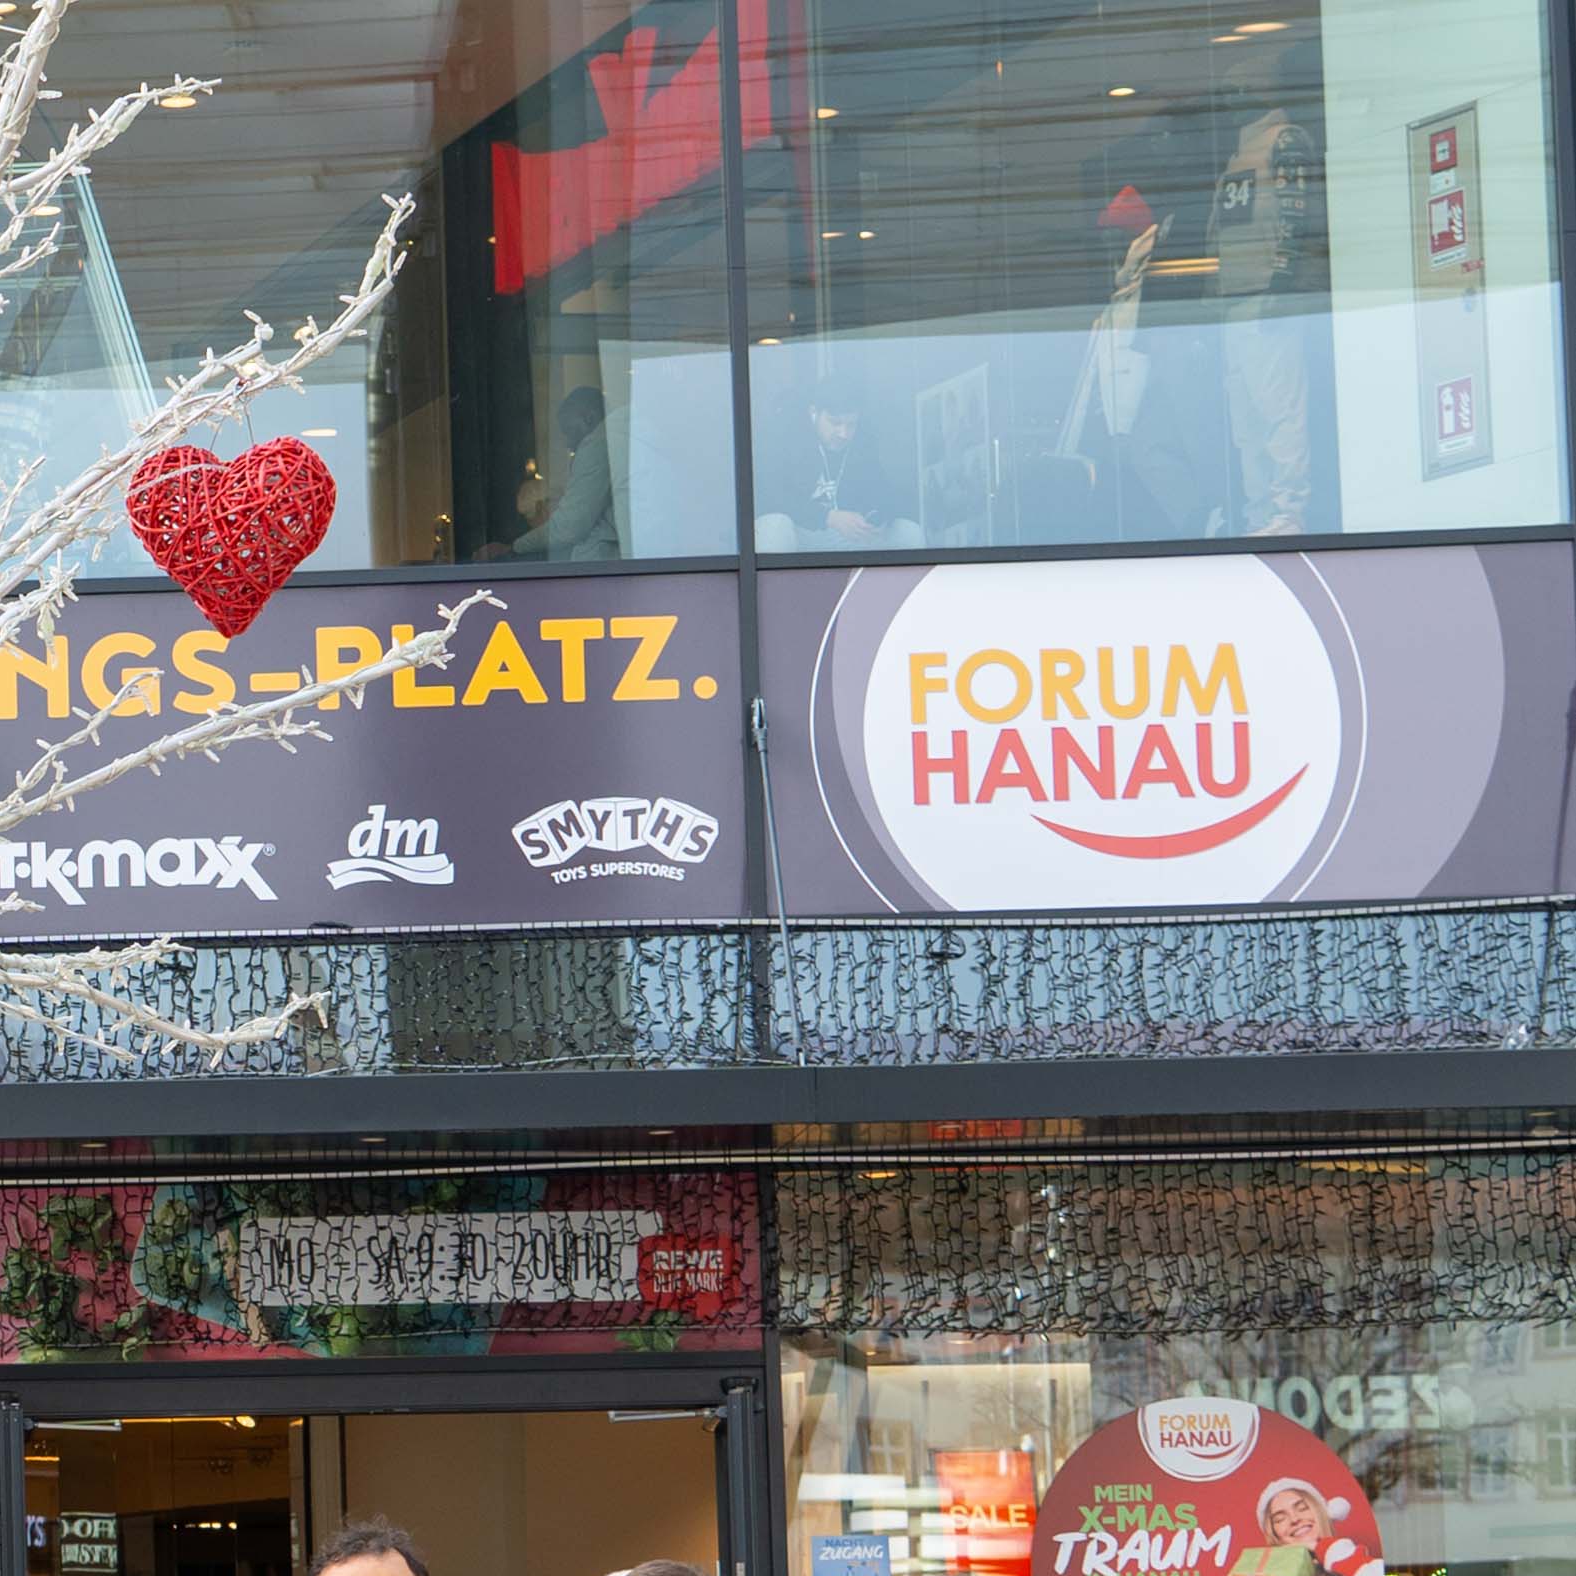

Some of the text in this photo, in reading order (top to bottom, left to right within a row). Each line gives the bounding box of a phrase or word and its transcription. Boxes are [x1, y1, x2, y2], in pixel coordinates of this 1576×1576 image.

[908, 642, 1249, 725] FORUM
[911, 720, 1251, 806] HANAU
[349, 805, 439, 857] dm
[520, 807, 715, 860] SMYTHS
[551, 861, 686, 884] TOYS SUPERSTORES
[653, 1250, 724, 1270] REWE
[1158, 1413, 1231, 1431] FORUM
[1160, 1431, 1232, 1448] HANAU
[1094, 1484, 1153, 1503] MEIN
[949, 1503, 1029, 1529] SALE
[1078, 1503, 1198, 1533] X-MAS
[818, 1544, 884, 1561] ZUGANG
